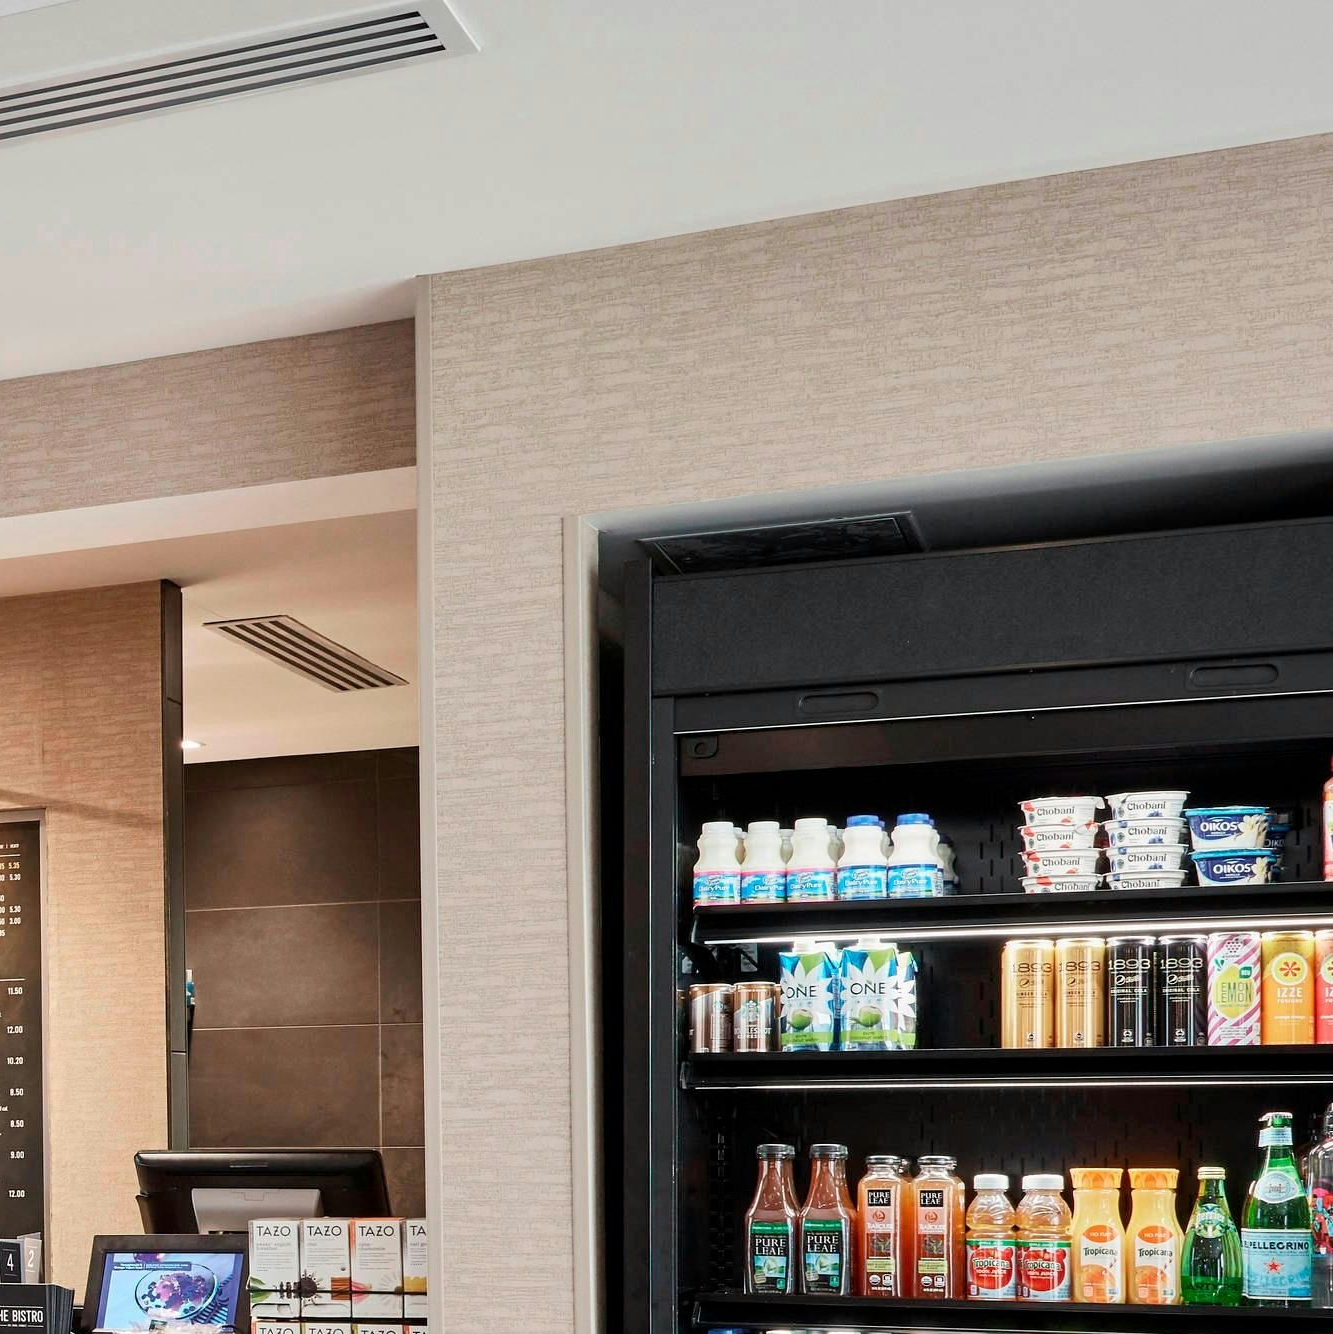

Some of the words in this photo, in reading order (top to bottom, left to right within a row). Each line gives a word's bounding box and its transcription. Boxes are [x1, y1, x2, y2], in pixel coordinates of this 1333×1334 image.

[1036, 806, 1075, 816] Chobani
[1126, 801, 1166, 811] Chobani
[1127, 826, 1168, 837] Chobani
[1199, 821, 1238, 833] OIKOS
[1036, 832, 1074, 842] Chobani
[1042, 857, 1080, 867] Chobani
[1127, 853, 1167, 863] Chobani
[1213, 863, 1251, 874] OIKOS
[844, 878, 878, 887] DairyPure
[893, 878, 928, 887] DairyPure
[1054, 882, 1091, 891] Chobani
[1120, 879, 1160, 889] Chobani
[1012, 962, 1053, 973] 1893
[1059, 960, 1101, 973] 1893
[1107, 958, 1151, 971] 1893
[1160, 957, 1204, 970] 1893
[7, 987, 23, 995] 11.50
[786, 985, 818, 999] ONE
[850, 982, 886, 995] ONE
[1277, 987, 1303, 998] IZZE
[6, 1025, 23, 1034] 12.00
[6, 1057, 24, 1065] 10.20
[9, 1088, 24, 1096] 8.50
[10, 1119, 24, 1128] 8.50
[10, 1151, 25, 1159] 9.00
[8, 1190, 25, 1198] 12.00
[868, 1191, 891, 1199] PURE
[920, 1192, 943, 1200] PURE
[920, 1198, 941, 1206] LEAF
[256, 1225, 291, 1237] TAZO
[306, 1225, 342, 1237] TAZO
[358, 1225, 395, 1237] TAZO
[754, 1237, 787, 1247] PURE
[806, 1235, 839, 1245] PURE
[755, 1246, 784, 1256] LEAF
[807, 1244, 837, 1253] LEAF
[1083, 1247, 1117, 1256] Tropicana
[1138, 1248, 1173, 1258] Tropicana
[6, 1253, 14, 1272] 4
[27, 1249, 34, 1268] 2
[972, 1258, 1010, 1269] Tropicana
[1024, 1259, 1061, 1270] Tropicana
[12, 1309, 44, 1323] BISTRO
